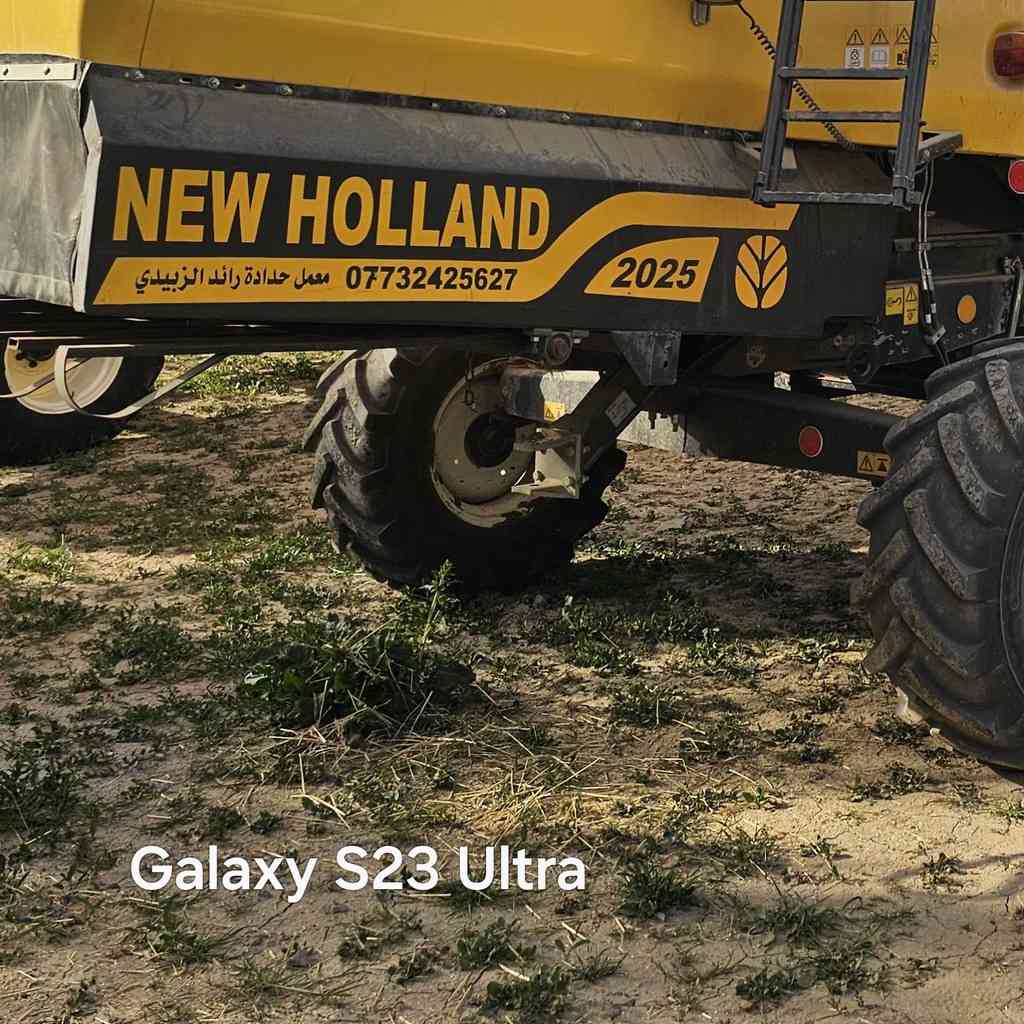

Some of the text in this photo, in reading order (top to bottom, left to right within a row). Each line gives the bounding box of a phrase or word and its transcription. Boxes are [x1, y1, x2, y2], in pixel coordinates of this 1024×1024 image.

[112, 166, 551, 251] NEW HOLLAND
[135, 265, 519, 295] معمل حدادة رائد الزبيدي 07732425627
[610, 256, 701, 289] 2025
